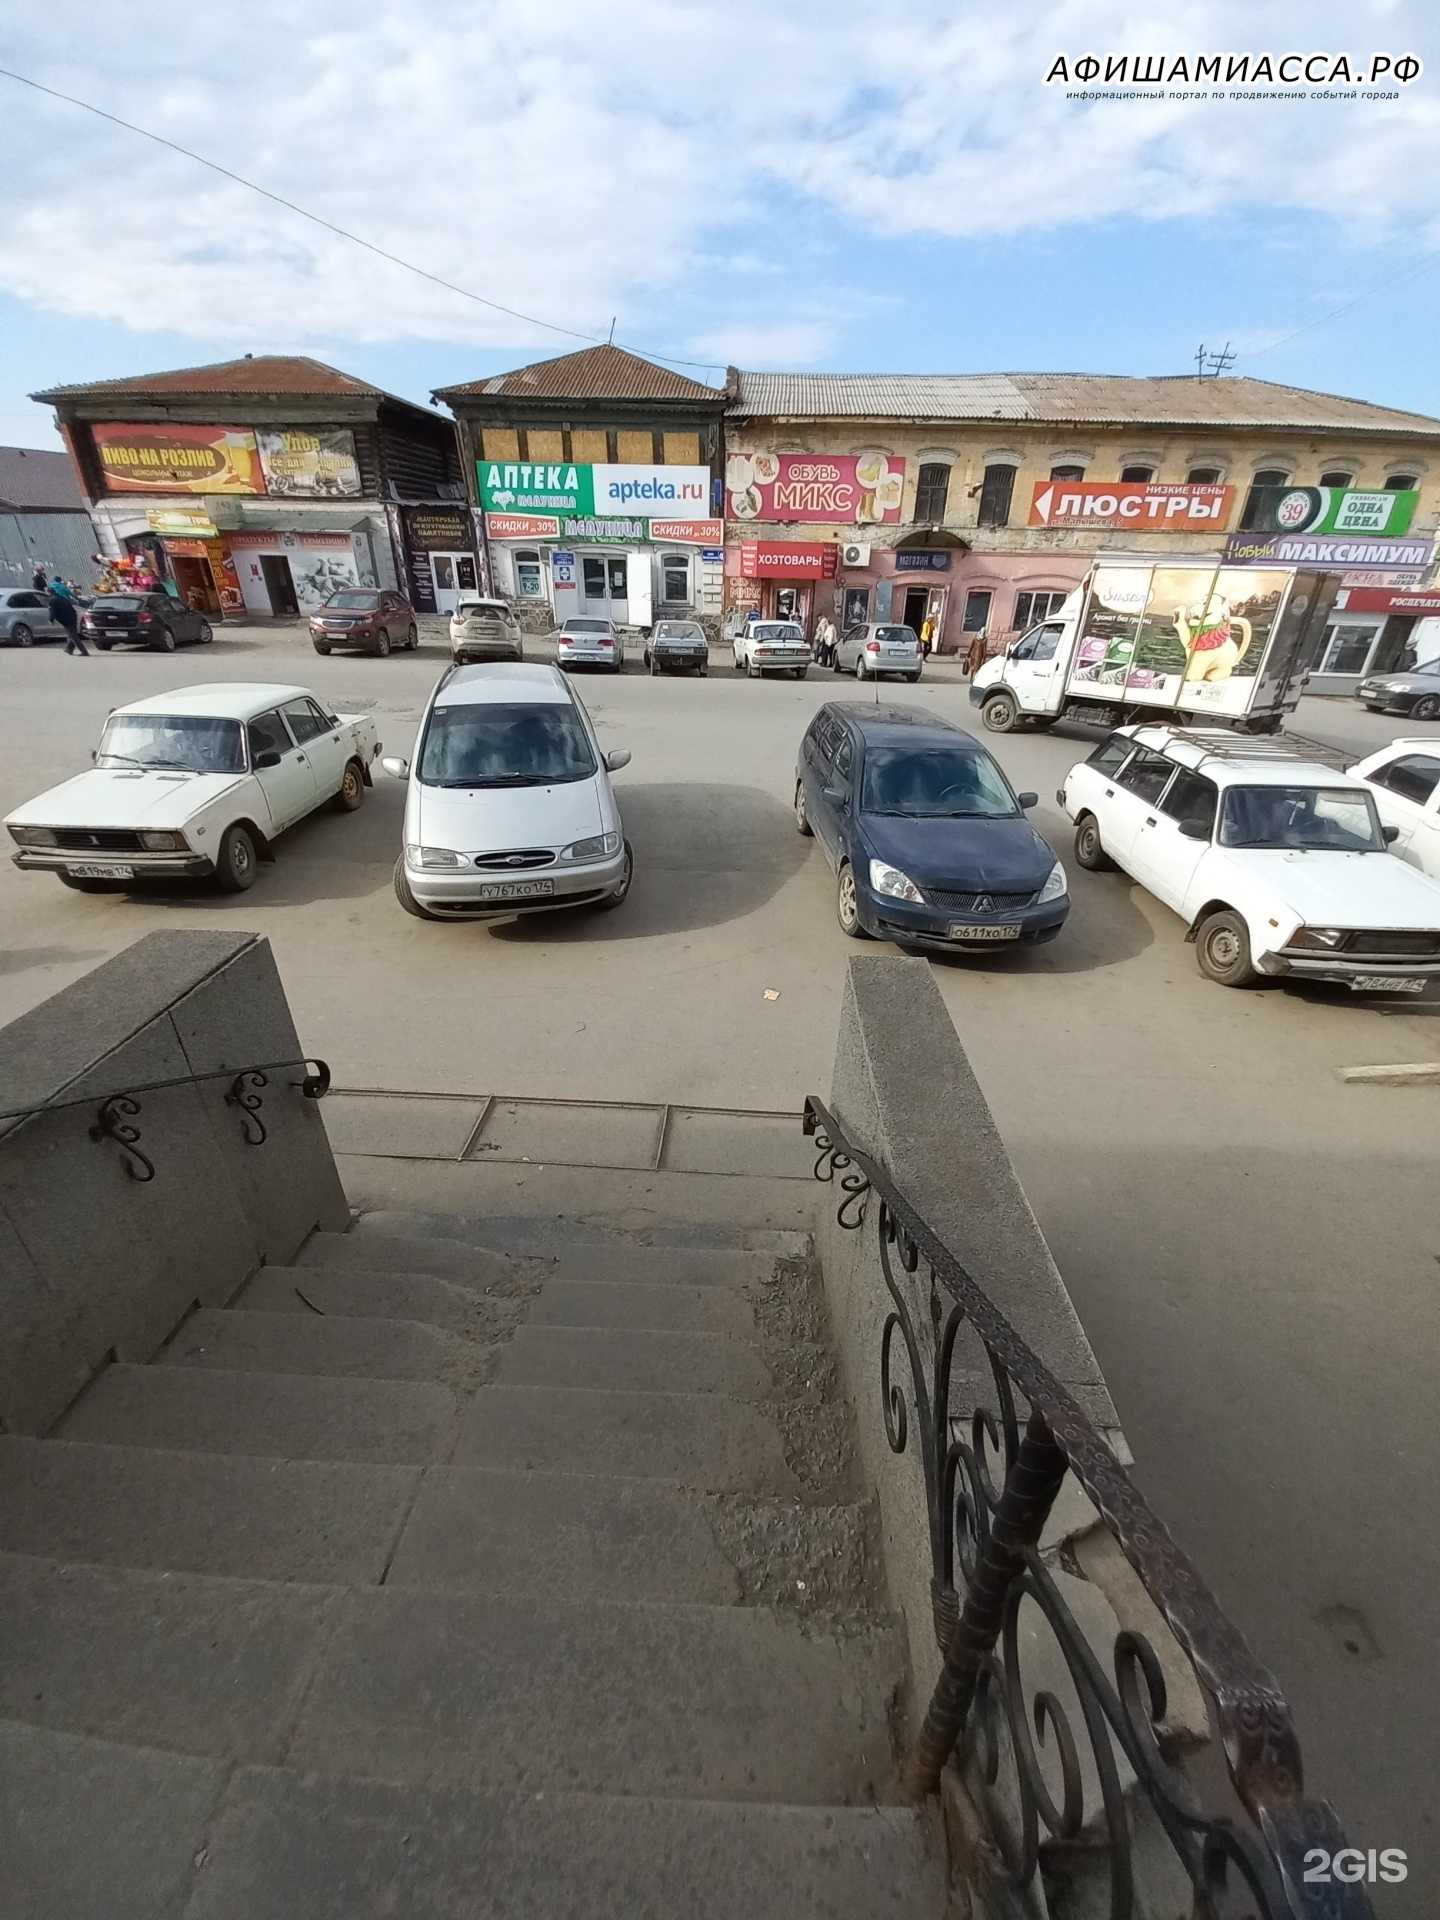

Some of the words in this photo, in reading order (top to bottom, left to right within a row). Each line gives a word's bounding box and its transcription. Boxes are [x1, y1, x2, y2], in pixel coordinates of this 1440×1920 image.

[139, 448, 160, 465] НА
[160, 449, 216, 467] РОЗЛИВ
[486, 464, 579, 490] АПТЕКА
[788, 463, 841, 482] ОБУВЬ
[609, 477, 703, 504] apteka.ru
[773, 482, 854, 512] МИКС
[1146, 486, 1188, 495] НИЗКИЕ
[1192, 487, 1226, 496] ЦЕНЫ
[1055, 494, 1223, 518] ЛЮСТРЫ
[1347, 503, 1384, 514] ОДНА
[489, 520, 529, 532] СКИДКИ
[536, 521, 557, 533] 30%
[653, 523, 693, 537] СКИДКИ
[700, 525, 721, 538] 30%
[1341, 516, 1379, 527] ЦЕНА
[758, 554, 822, 566] ХОЗТОВАРЫ
[1278, 542, 1426, 563] МАКСИМУМ
